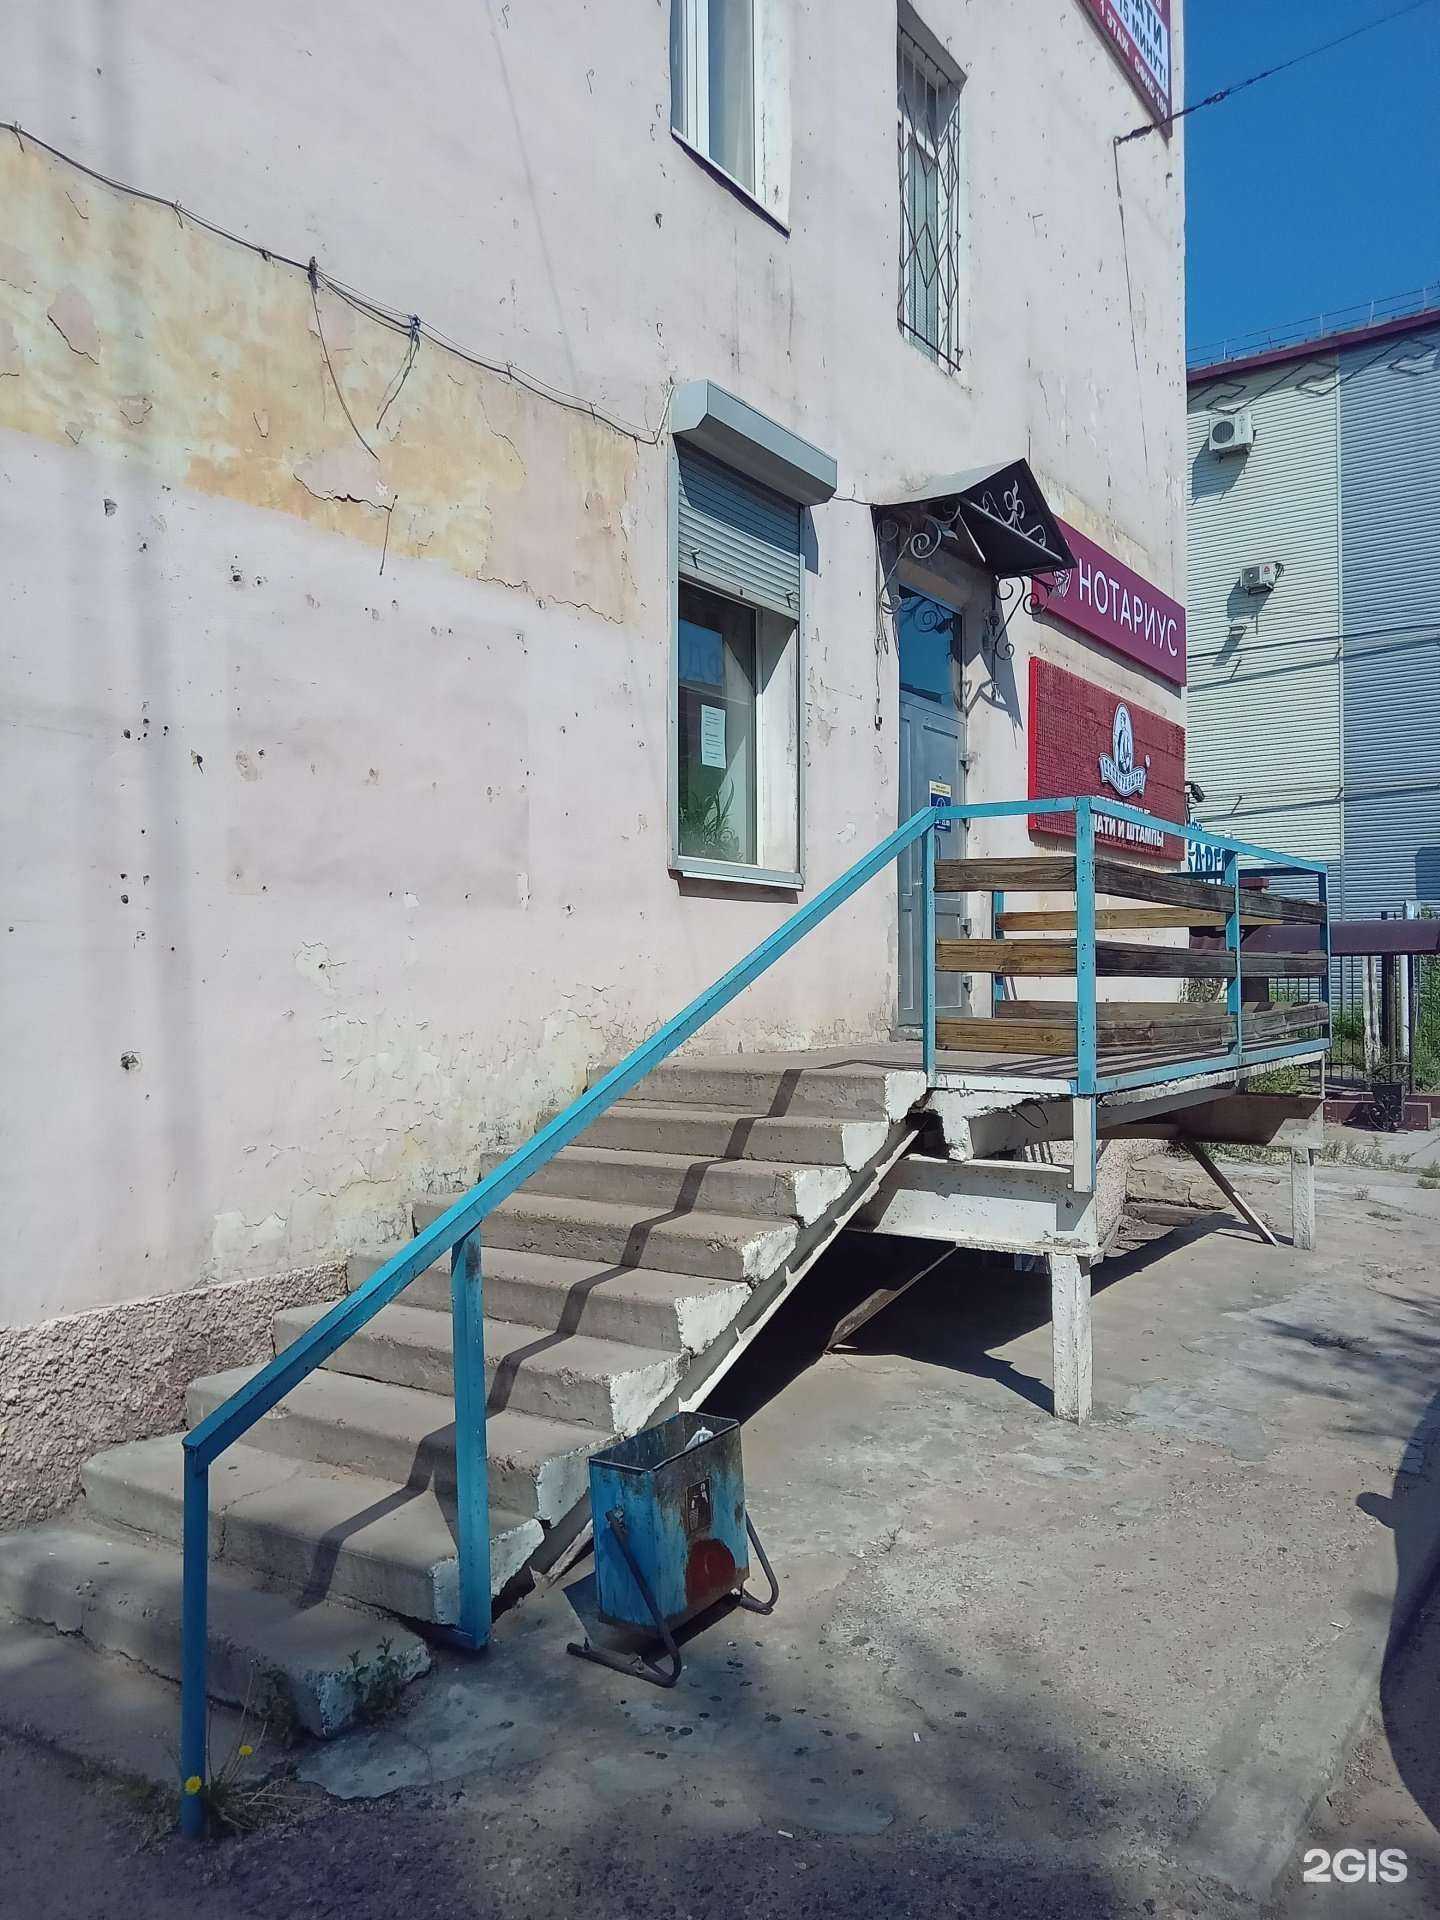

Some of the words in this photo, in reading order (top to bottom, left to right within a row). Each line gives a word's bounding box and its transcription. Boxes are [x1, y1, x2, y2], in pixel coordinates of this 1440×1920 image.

[1078, 558, 1179, 657] НОТАРИУС
[1117, 819, 1125, 839] И
[1126, 821, 1165, 848] ШТАМПЫ
